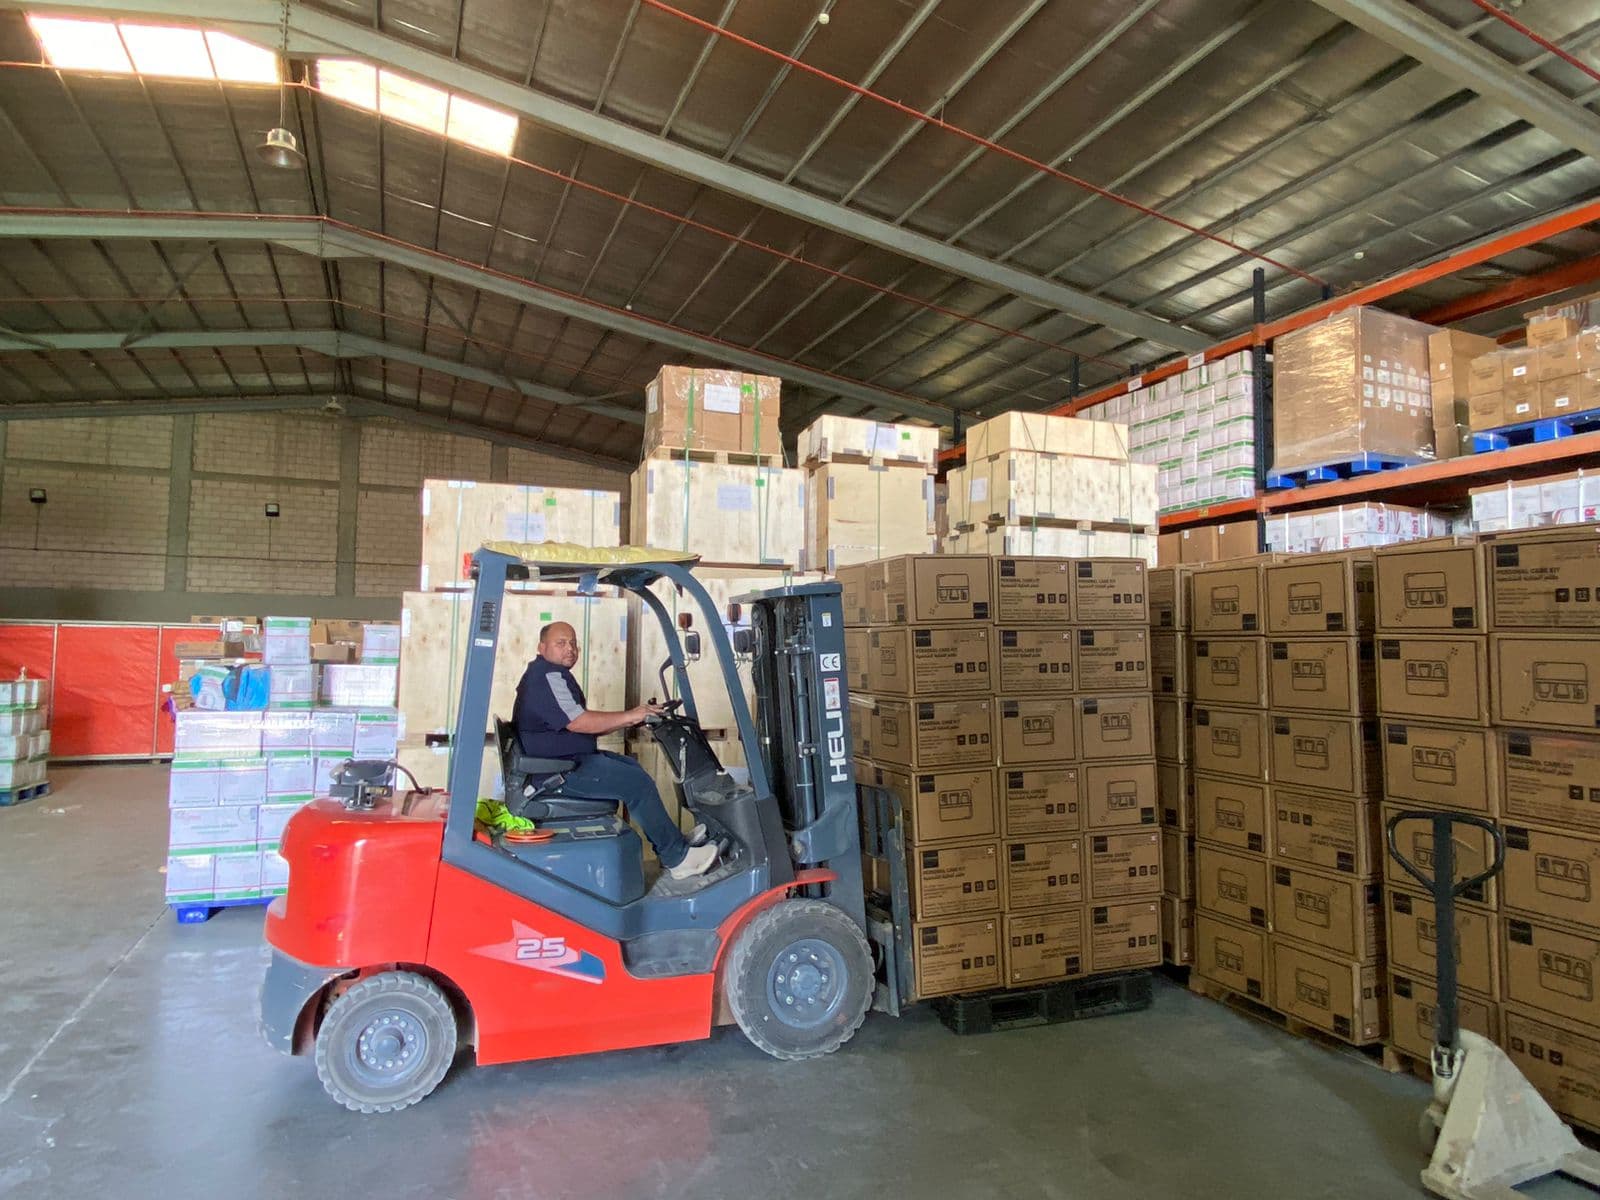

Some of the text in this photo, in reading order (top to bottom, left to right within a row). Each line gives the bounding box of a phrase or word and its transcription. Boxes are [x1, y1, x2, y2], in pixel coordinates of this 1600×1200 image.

[822, 656, 840, 670] CE
[826, 710, 848, 782] HELI
[516, 936, 566, 960] 25
